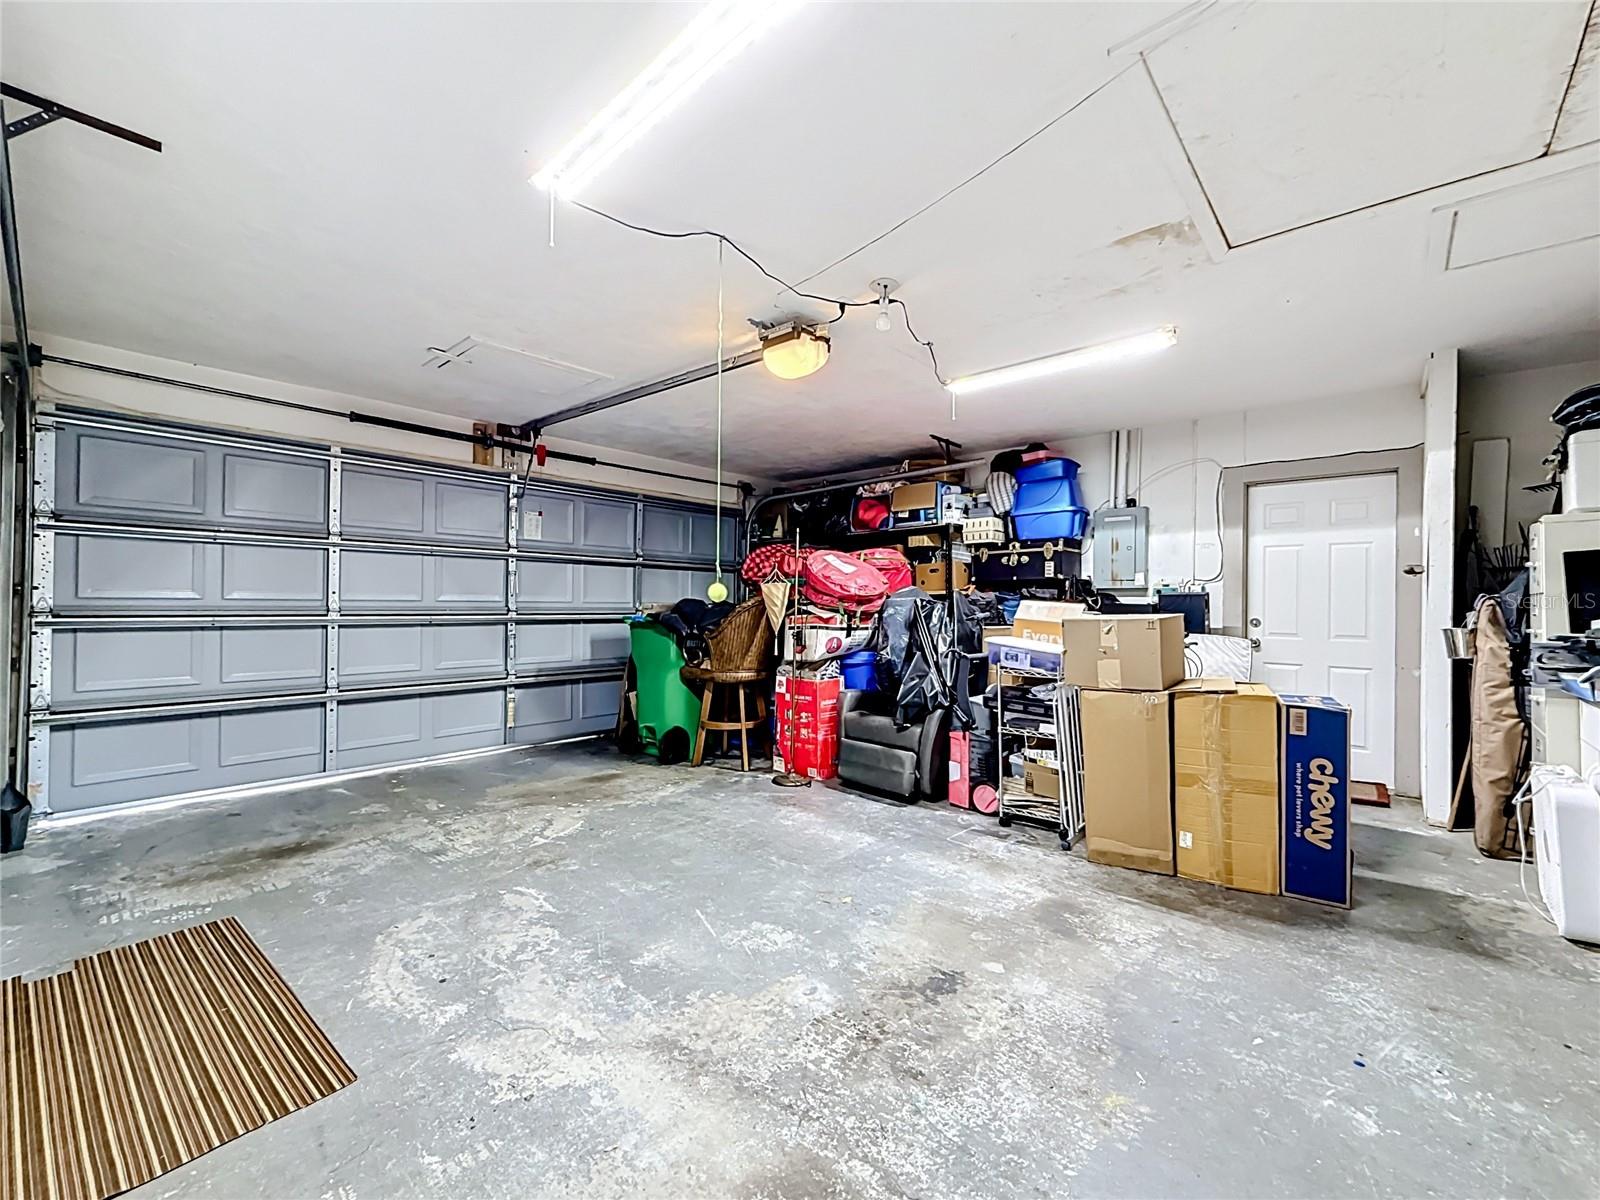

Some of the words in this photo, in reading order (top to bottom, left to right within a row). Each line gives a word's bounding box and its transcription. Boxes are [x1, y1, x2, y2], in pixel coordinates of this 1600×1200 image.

[1295, 762, 1304, 784] where
[1294, 785, 1303, 797] pet
[1295, 798, 1304, 819] lovers
[1303, 757, 1339, 850] chewy
[1294, 821, 1303, 837] shop
